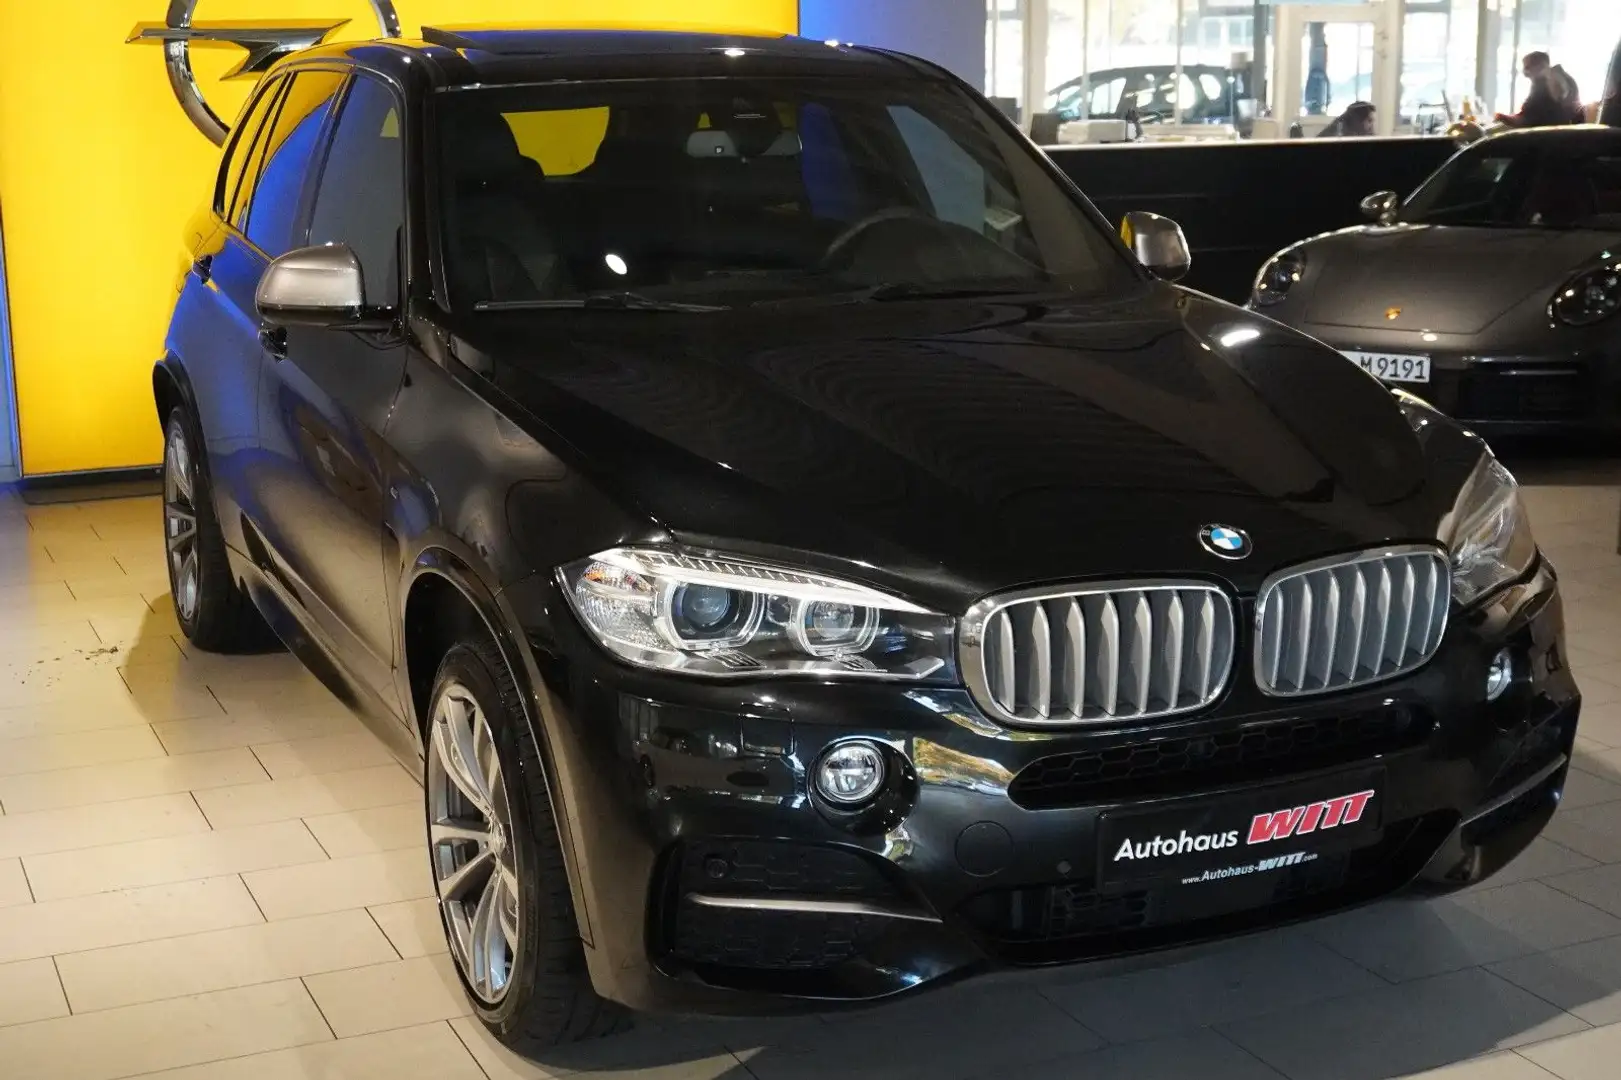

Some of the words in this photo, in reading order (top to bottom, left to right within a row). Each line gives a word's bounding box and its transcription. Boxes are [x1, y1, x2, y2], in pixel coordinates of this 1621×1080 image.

[1114, 830, 1239, 862] Autohaus
[1246, 789, 1374, 845] WITT
[1181, 852, 1318, 884] www.Autohaus-WITT.com
